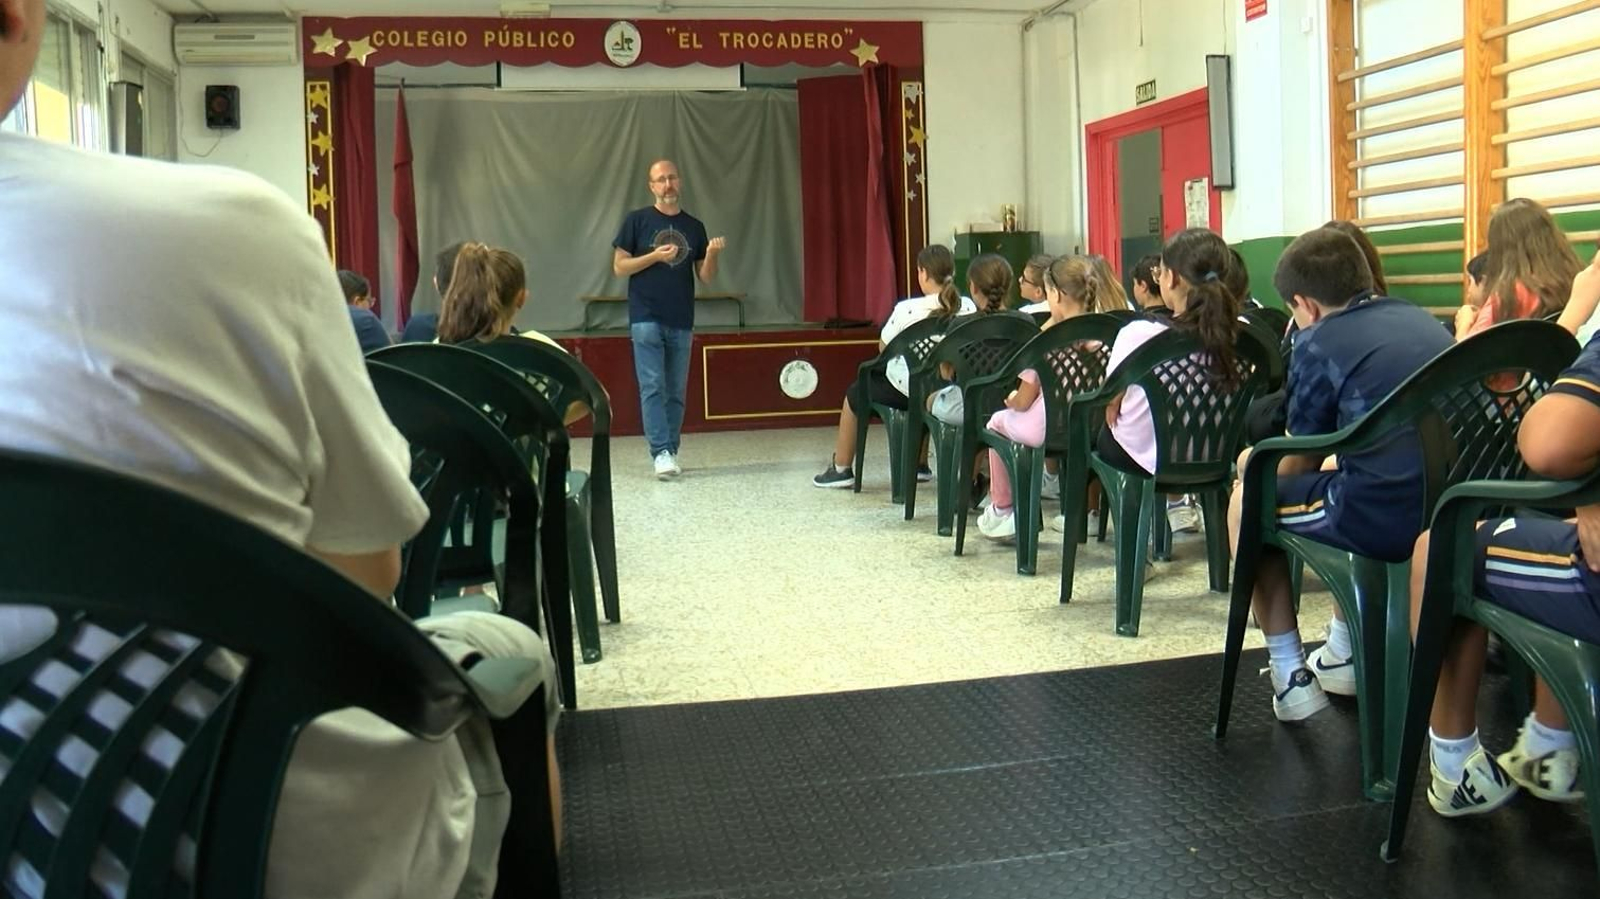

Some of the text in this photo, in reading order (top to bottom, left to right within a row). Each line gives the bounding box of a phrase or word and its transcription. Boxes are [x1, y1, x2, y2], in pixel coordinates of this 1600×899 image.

[372, 24, 853, 49] COLEGIO PÚBLICO "EL TROCADERO"
